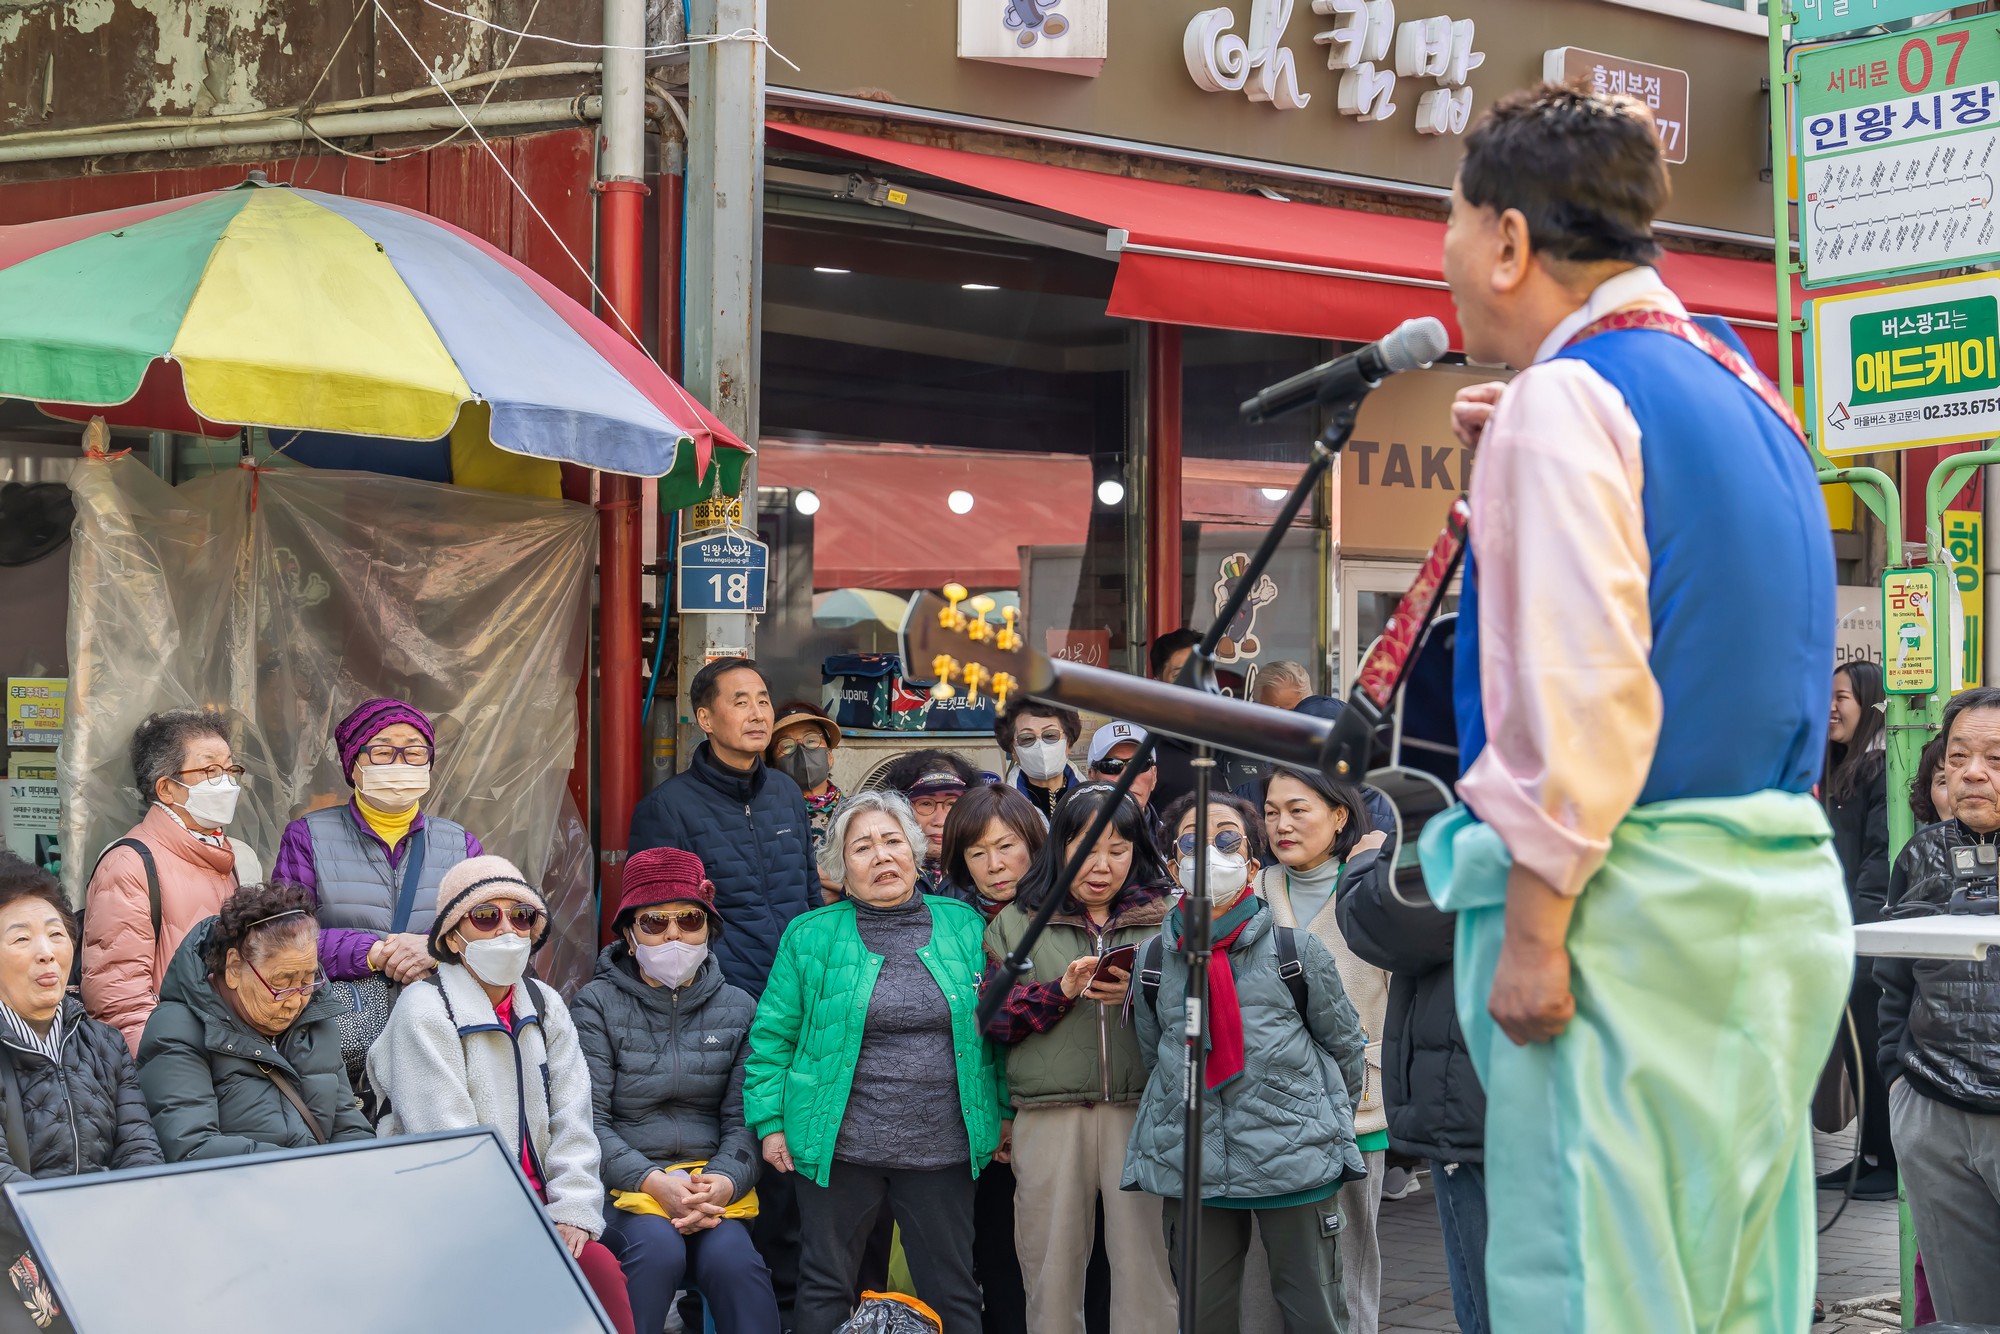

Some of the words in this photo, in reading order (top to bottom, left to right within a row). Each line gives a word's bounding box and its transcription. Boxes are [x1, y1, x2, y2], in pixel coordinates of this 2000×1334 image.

[1827, 60, 1889, 94] 서대문
[1898, 30, 1970, 94] 07
[1809, 86, 1995, 151] 인왕시장
[1881, 310, 1968, 338] 버스광고는
[1856, 336, 1996, 393] 애드케이
[1854, 414, 1886, 427] 마을버스
[1888, 409, 1921, 423] 광고문의
[701, 544, 751, 557] 인왕시장길
[708, 573, 746, 603] 18
[11, 686, 26, 698] 무료
